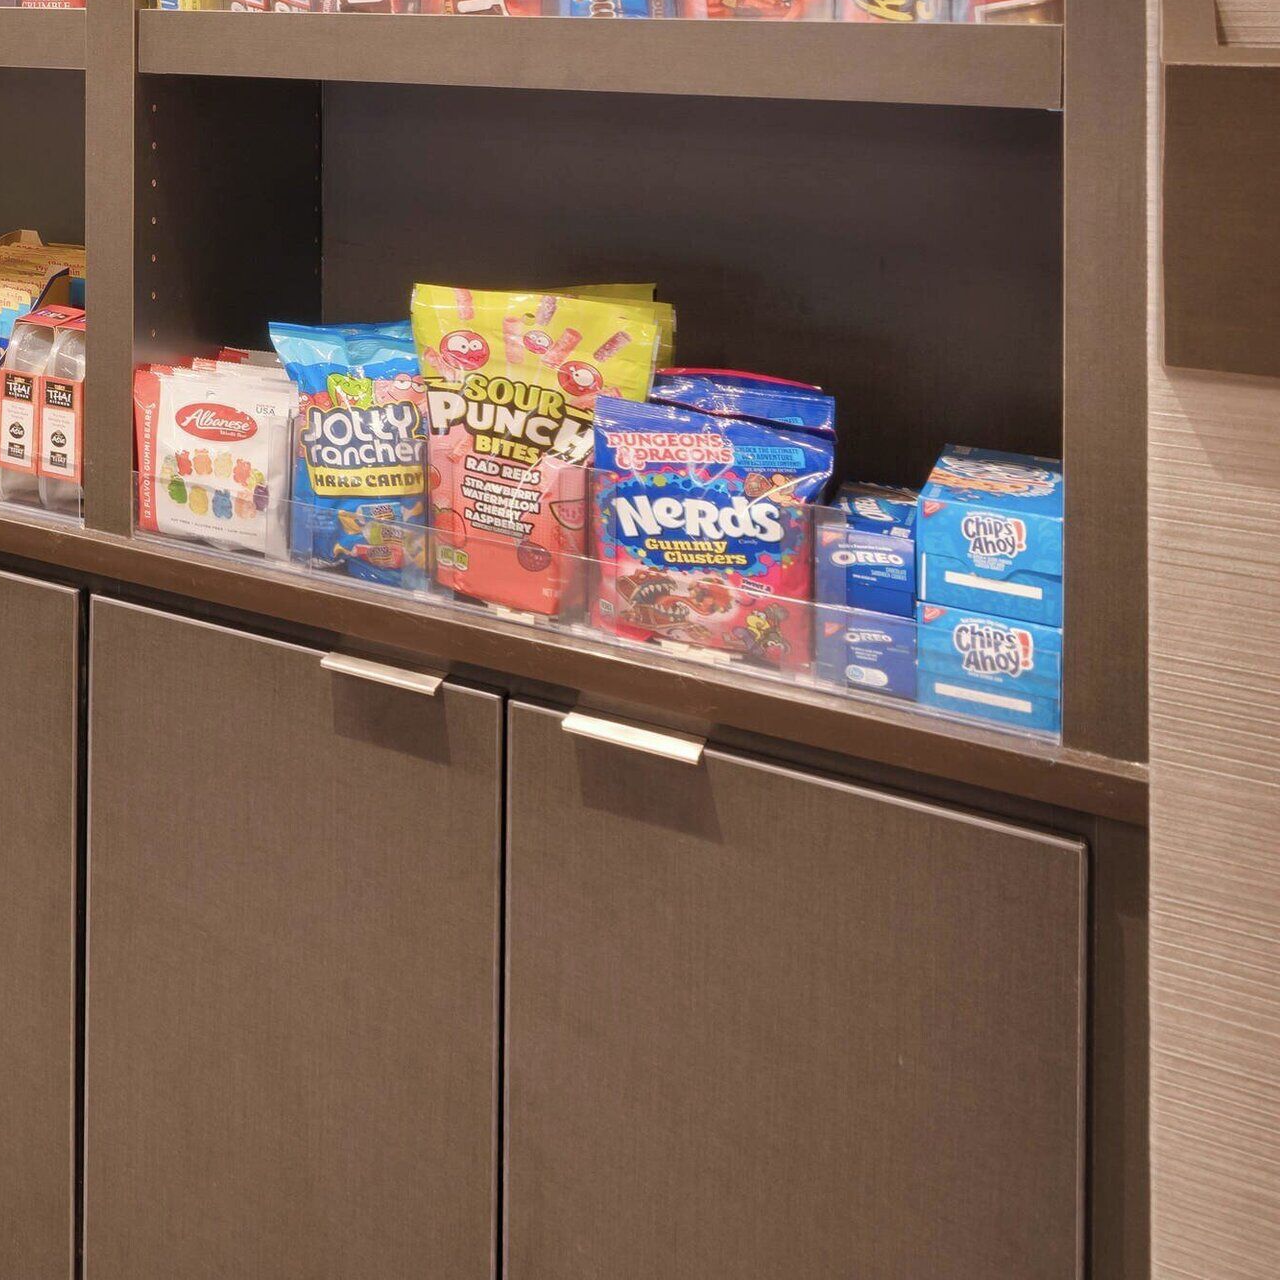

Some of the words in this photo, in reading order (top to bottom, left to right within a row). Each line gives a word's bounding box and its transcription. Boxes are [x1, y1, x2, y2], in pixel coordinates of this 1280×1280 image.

[6, 381, 32, 395] THAI
[46, 388, 72, 402] THAI
[464, 373, 566, 416] SOUR
[182, 408, 252, 432] Albanese
[255, 406, 277, 416] USA
[304, 404, 413, 446] JOLLY
[428, 389, 595, 462] PUNCH
[310, 438, 425, 467] rancher
[474, 434, 541, 464] BITES
[608, 433, 725, 448] DUNGEONS
[143, 440, 152, 472] GUMMI
[634, 447, 735, 464] DRAGONS
[313, 472, 363, 488] HARD
[368, 472, 425, 489] CANDY
[465, 456, 500, 477] RAD
[500, 463, 542, 485] REDS
[143, 472, 151, 508] FLAVOR
[461, 486, 541, 514] WATERMELON
[464, 476, 542, 503] STRAWBERRY
[464, 509, 535, 534] RASPBERRY
[475, 502, 523, 521] CHERRY
[963, 516, 1013, 539] Chips
[645, 538, 729, 556] Gummy
[664, 551, 748, 566] Clusters
[831, 549, 906, 566] OREO
[843, 631, 893, 644] OREO
[954, 624, 1017, 653] Chips
